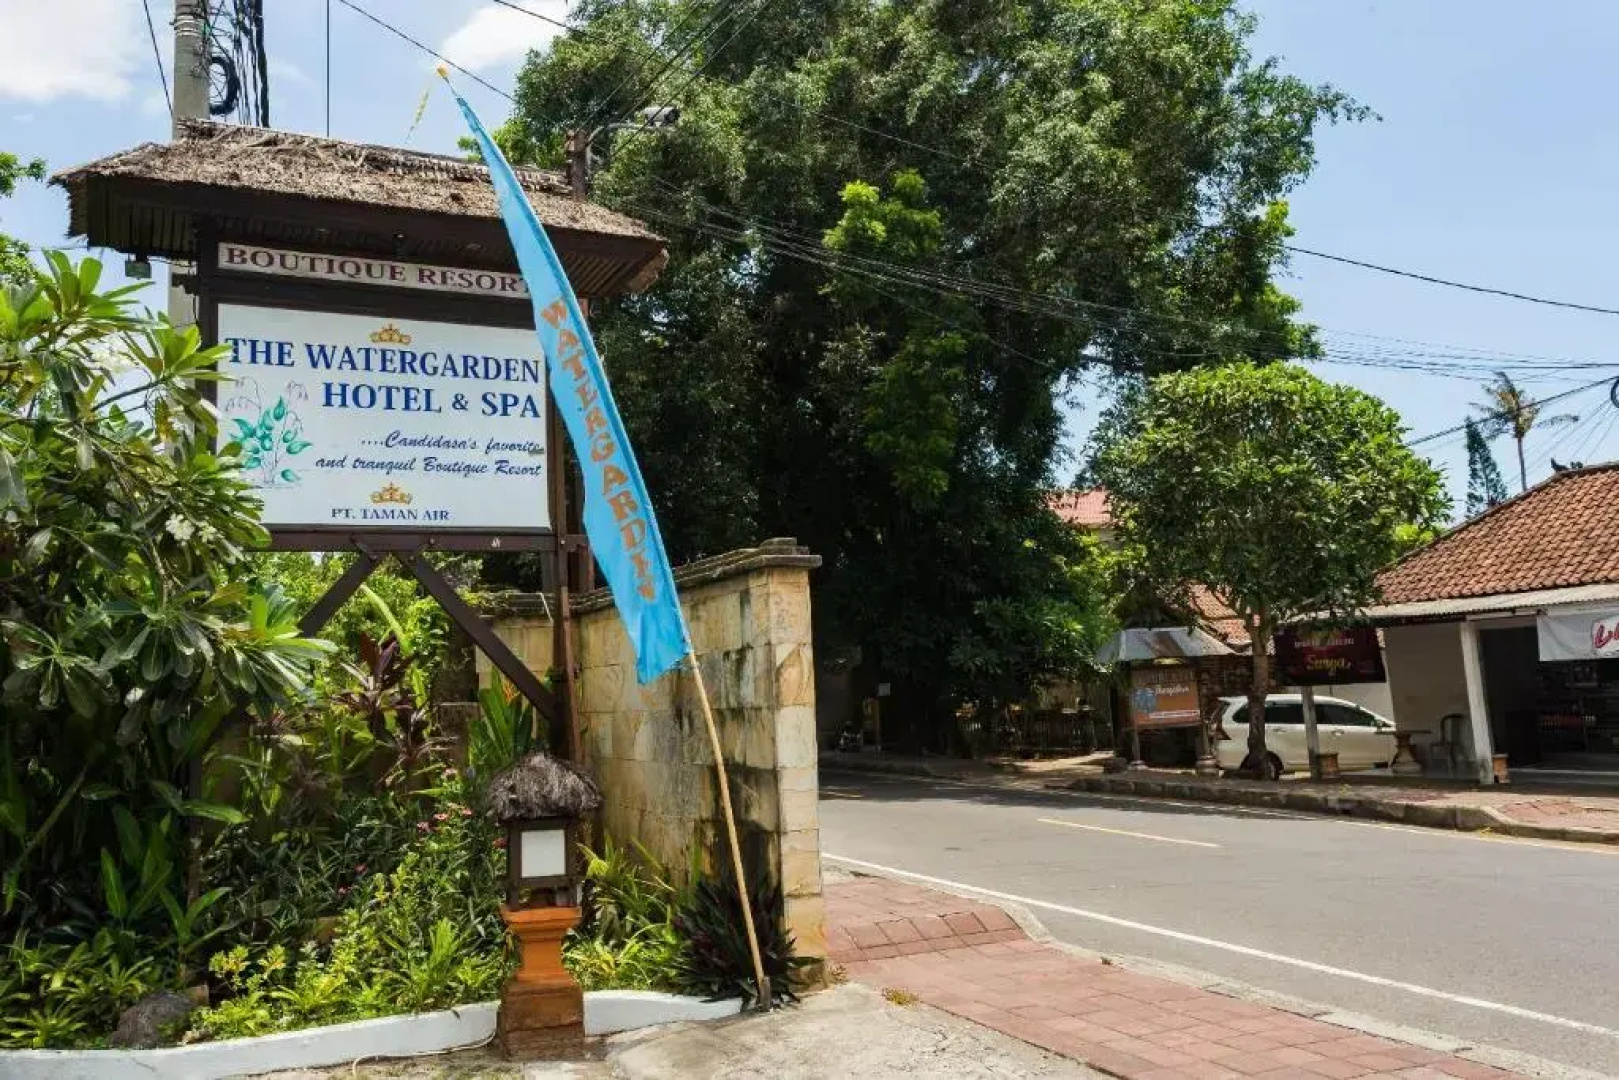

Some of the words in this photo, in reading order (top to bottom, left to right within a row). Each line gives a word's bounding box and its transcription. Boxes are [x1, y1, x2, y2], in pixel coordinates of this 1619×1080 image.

[225, 247, 406, 282] BOUTIQUE
[225, 337, 295, 368] THE
[304, 343, 540, 383] WATERGARDEN
[322, 382, 441, 413] HOTEL
[452, 393, 469, 411] &
[481, 392, 541, 418] SPA
[315, 455, 347, 469] and
[352, 456, 416, 475] tranquil
[423, 456, 488, 477] Boutique
[494, 459, 542, 476] Resort
[331, 508, 356, 520] PT.
[361, 508, 418, 520] TAMAN
[423, 510, 450, 520] AIR
